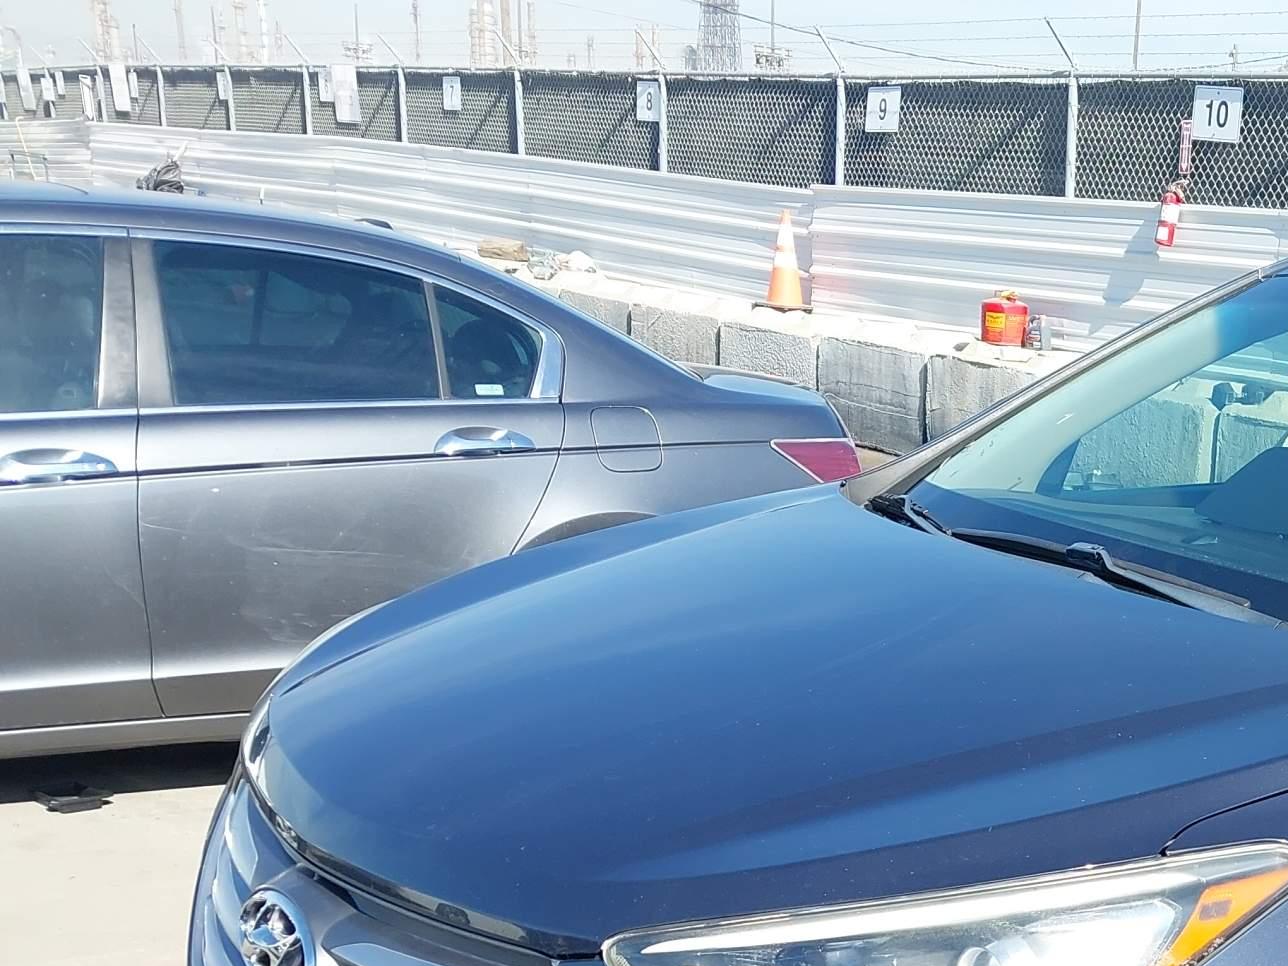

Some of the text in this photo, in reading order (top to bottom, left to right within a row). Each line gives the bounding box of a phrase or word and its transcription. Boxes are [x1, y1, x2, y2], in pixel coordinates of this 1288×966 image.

[646, 91, 653, 111] 8
[879, 98, 887, 121] 9
[1205, 99, 1229, 128] 10
